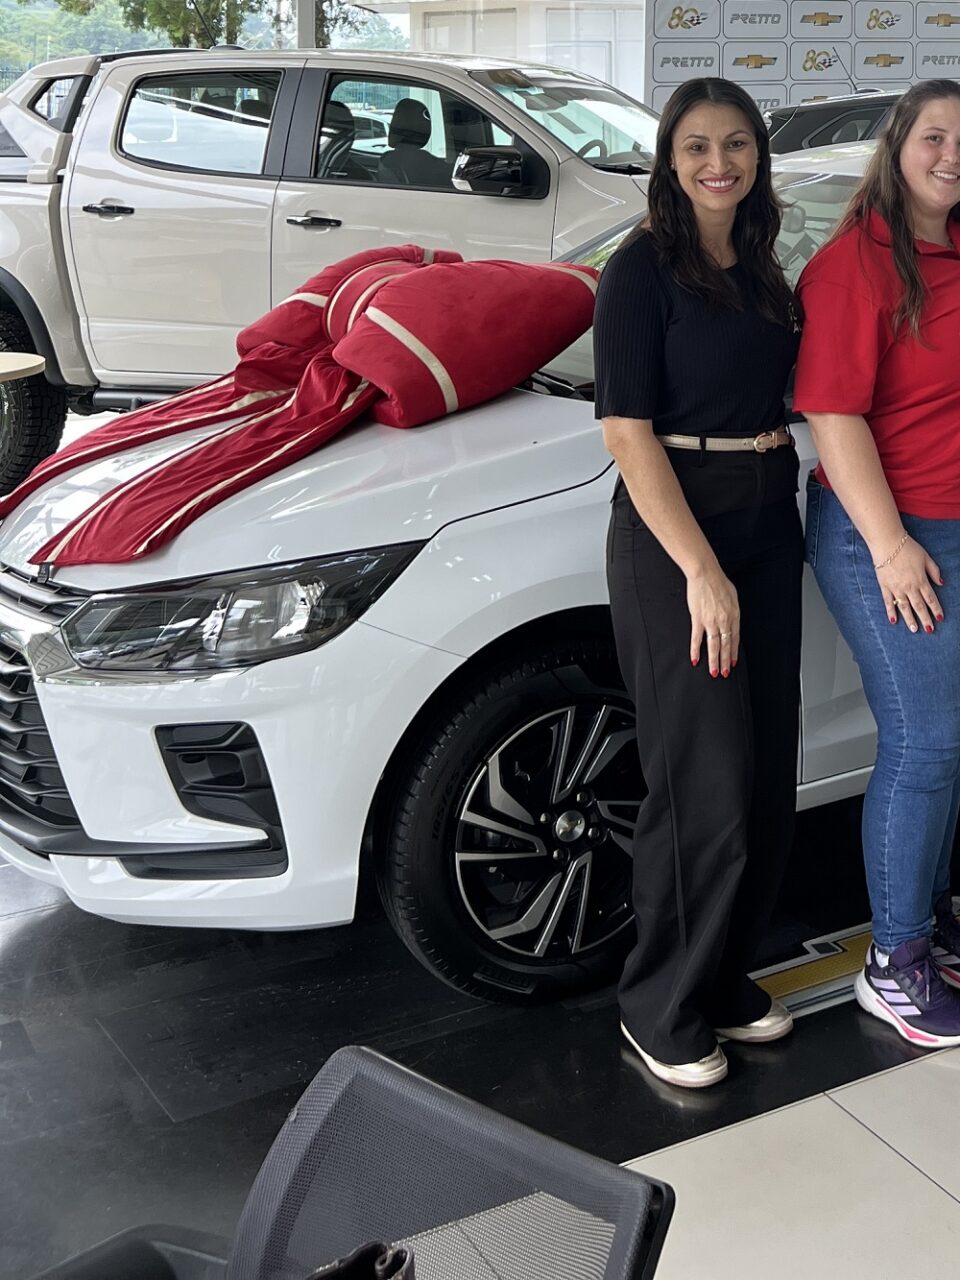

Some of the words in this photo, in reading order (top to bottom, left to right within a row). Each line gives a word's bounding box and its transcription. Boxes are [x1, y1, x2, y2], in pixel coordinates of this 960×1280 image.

[729, 13, 781, 25] PRETTO
[660, 56, 715, 68] PRETTO
[756, 98, 781, 109] TTO
